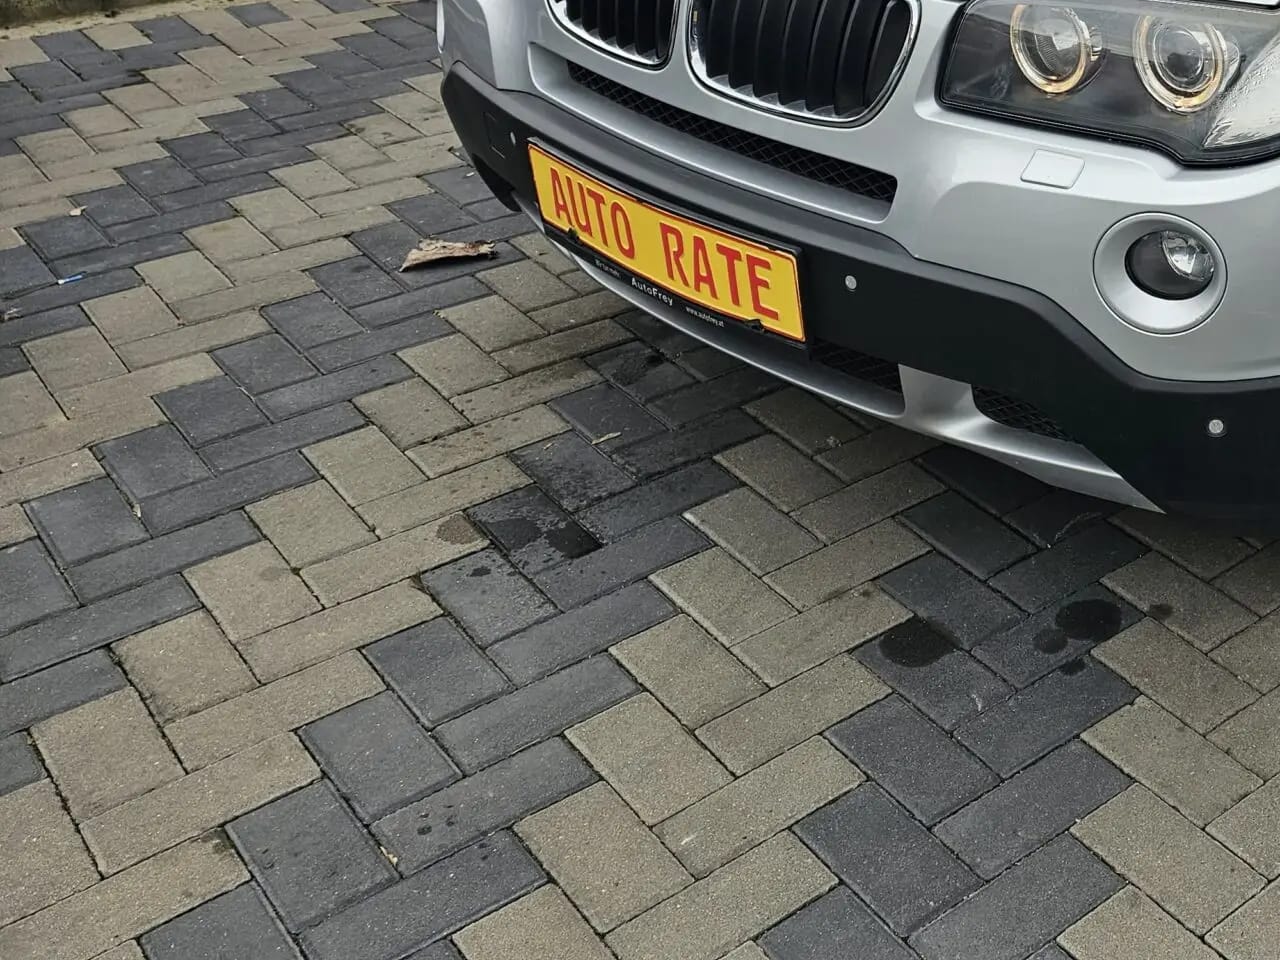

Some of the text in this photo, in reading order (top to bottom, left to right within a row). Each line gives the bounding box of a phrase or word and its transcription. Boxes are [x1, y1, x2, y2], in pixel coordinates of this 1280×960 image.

[549, 166, 780, 321] AUTO RATE
[631, 277, 673, 306] AutoFrey
